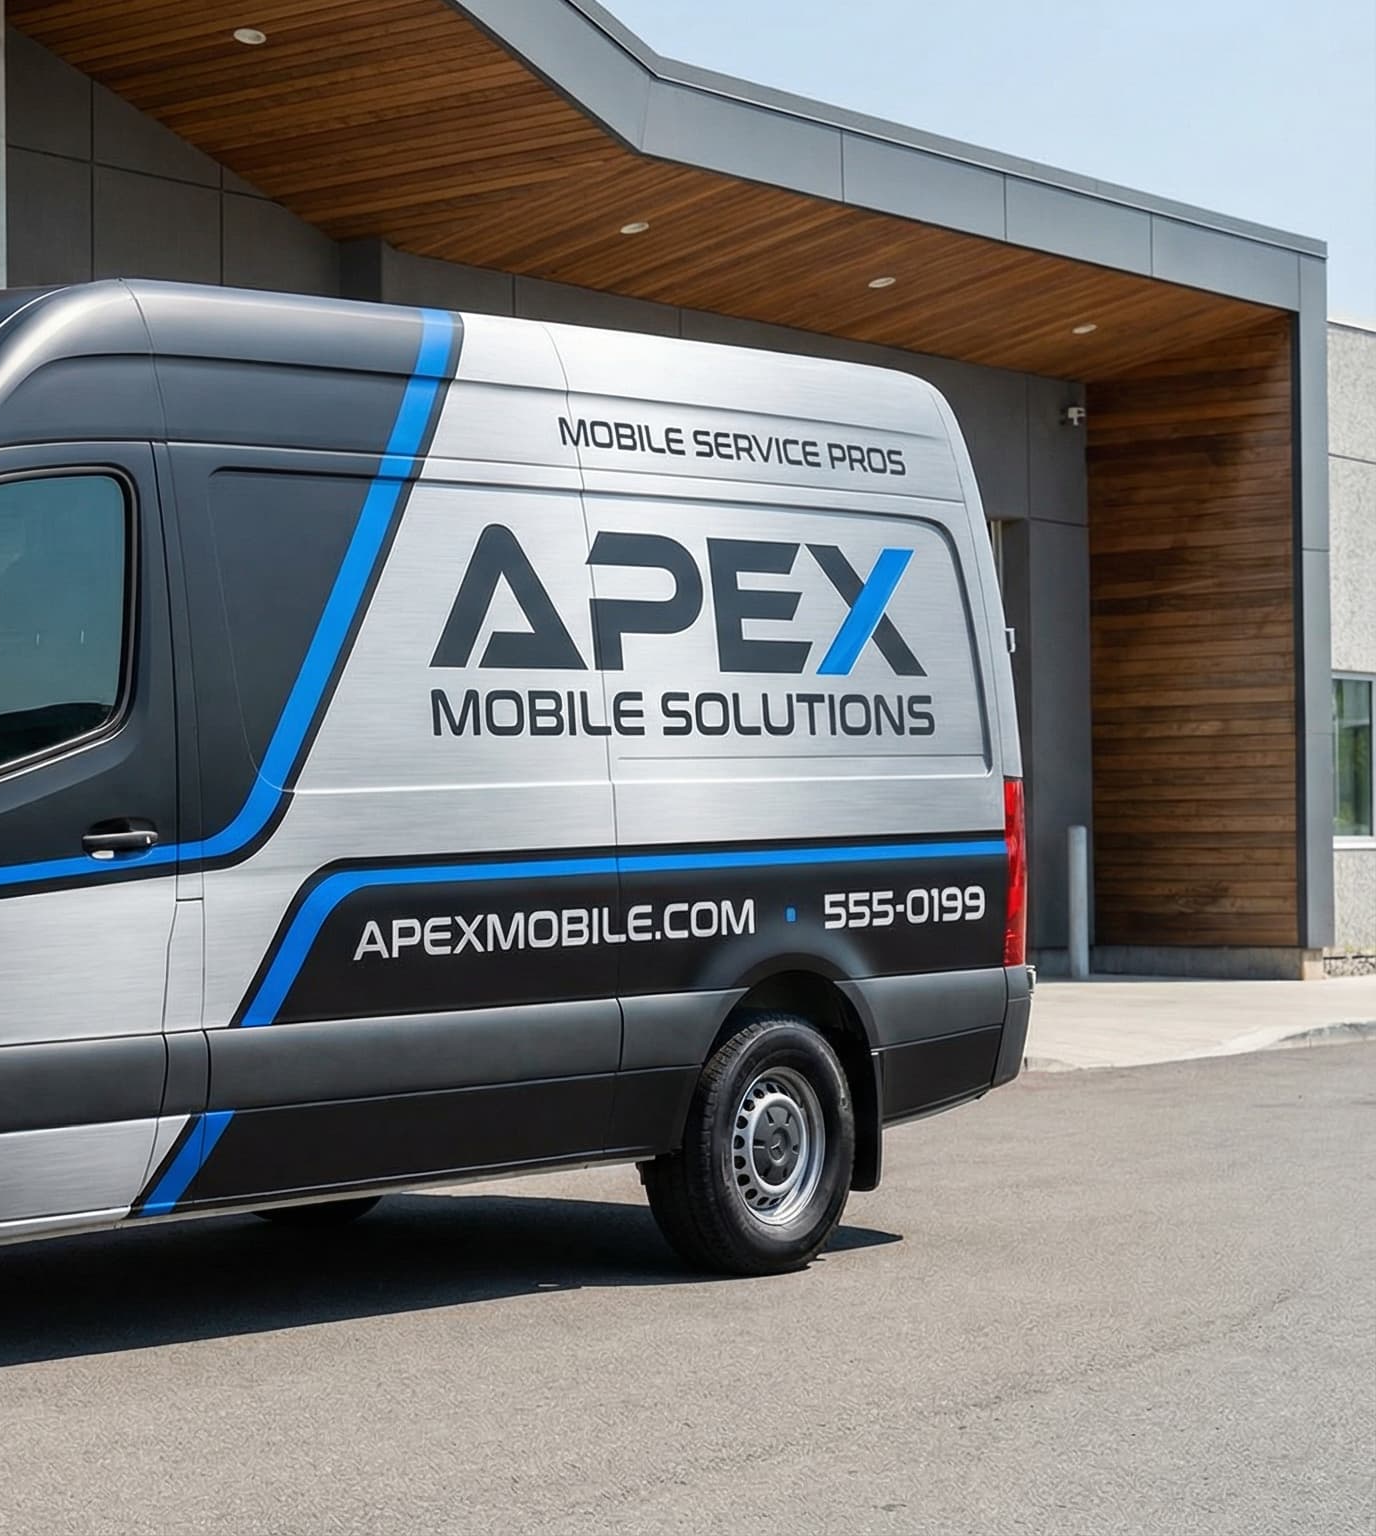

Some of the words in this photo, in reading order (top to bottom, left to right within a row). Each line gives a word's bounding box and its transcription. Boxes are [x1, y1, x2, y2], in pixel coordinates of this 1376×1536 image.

[558, 417, 686, 456] MOBILE
[693, 430, 822, 468] SERVICE
[827, 443, 907, 476] PROS
[429, 524, 928, 677] APEX
[431, 689, 645, 737] MOBILE
[661, 692, 935, 737] SOLUTIONS
[353, 900, 756, 961] APEXMOBILE.COM
[824, 886, 985, 930] 555-0199
